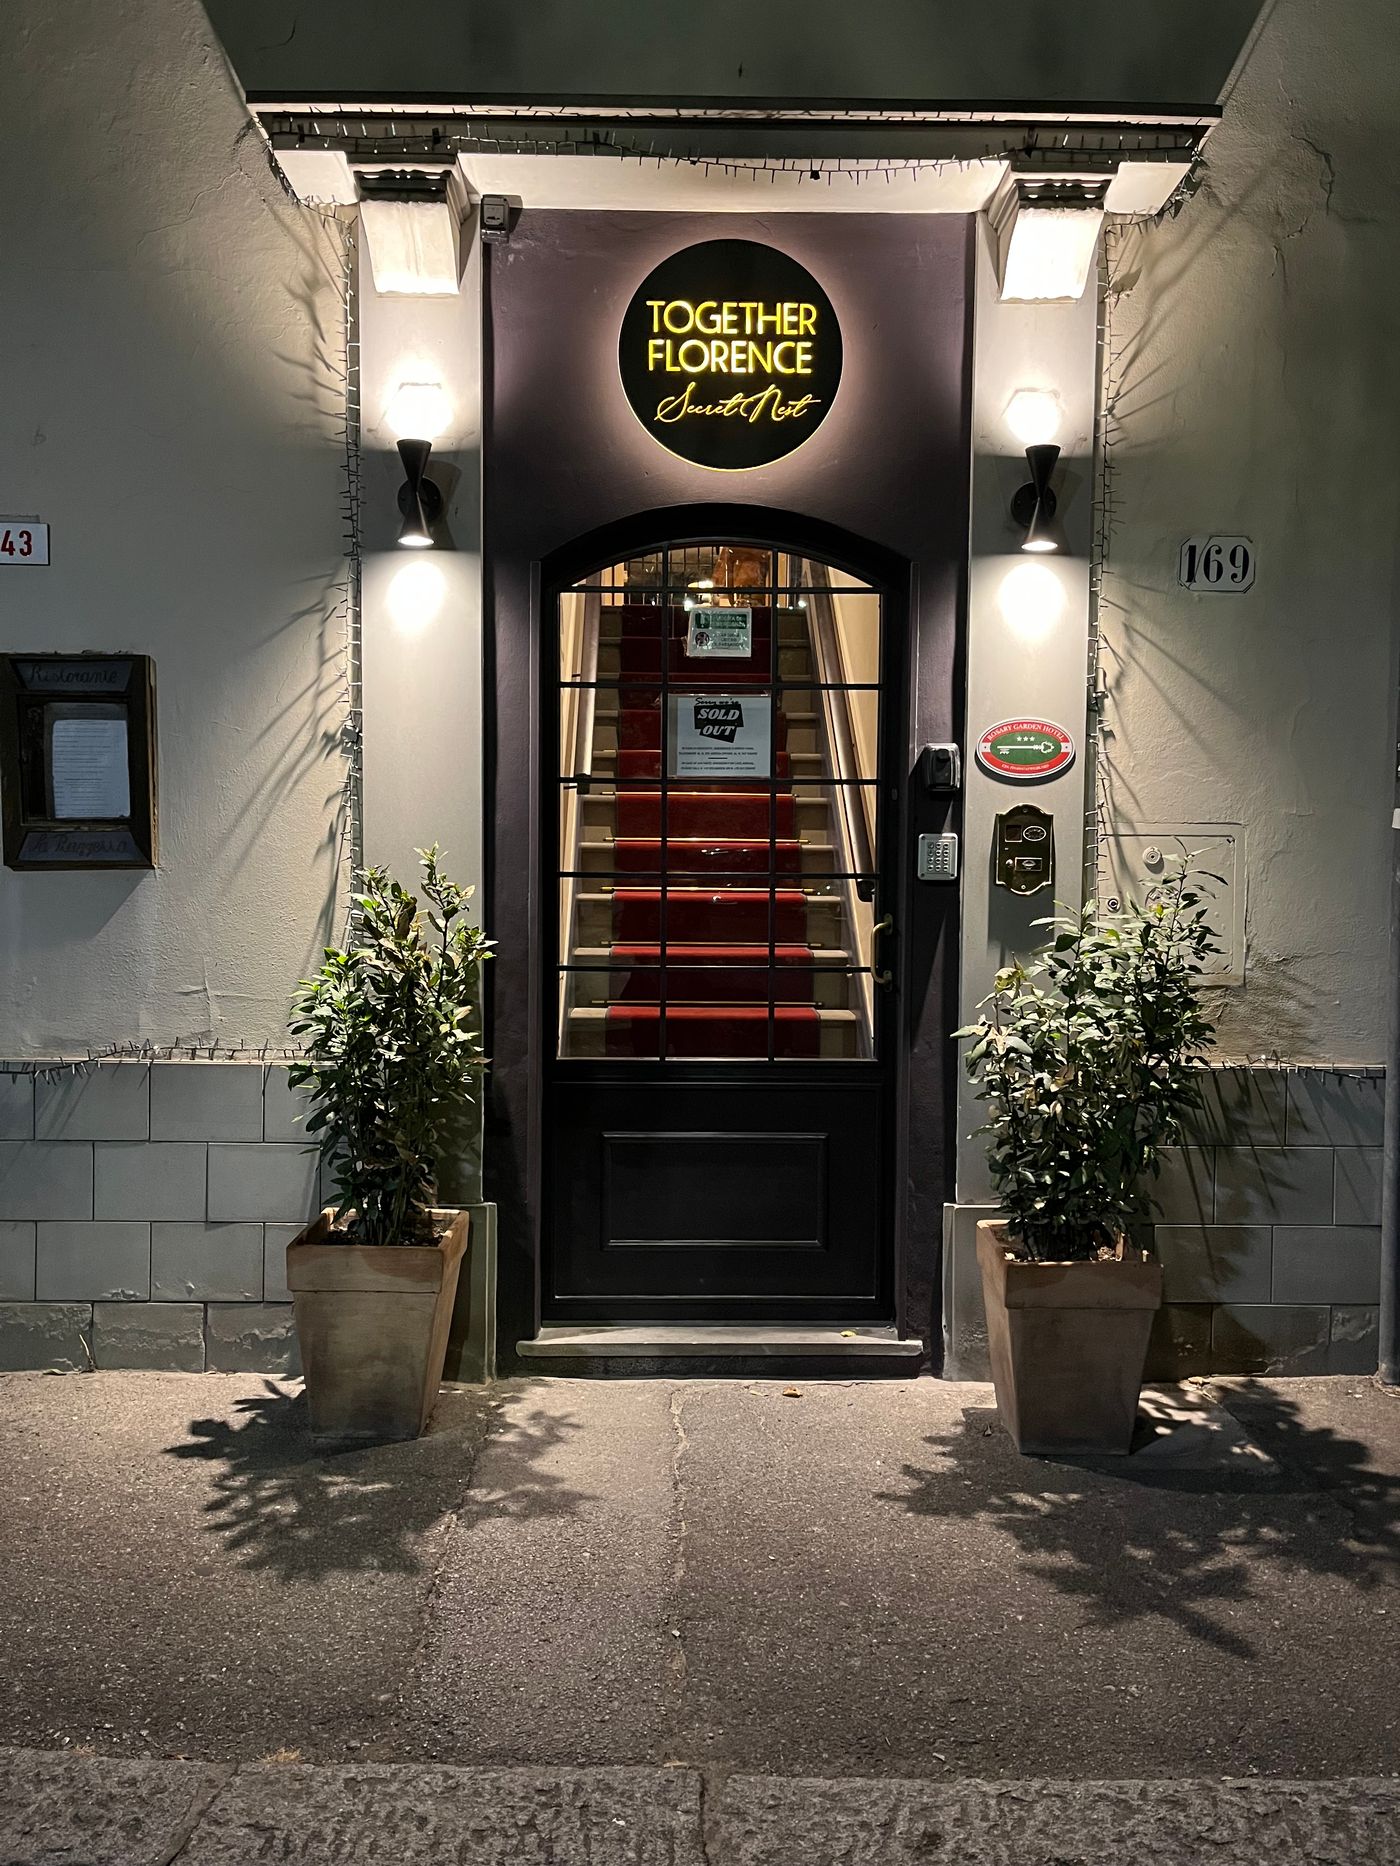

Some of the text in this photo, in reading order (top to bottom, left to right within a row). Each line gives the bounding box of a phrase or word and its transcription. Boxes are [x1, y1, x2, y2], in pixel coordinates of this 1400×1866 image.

[645, 300, 818, 336] TOGETHER
[648, 338, 813, 374] FLORENCE
[653, 381, 822, 423] Secret Nest
[0, 529, 33, 557] 43
[1184, 544, 1250, 584] 169
[28, 663, 120, 684] Ristorante
[695, 697, 717, 706] Sorry
[697, 708, 740, 721] SOLD
[702, 724, 736, 736] OUT
[986, 723, 1064, 741] ROSARY GARDEN HOTEL
